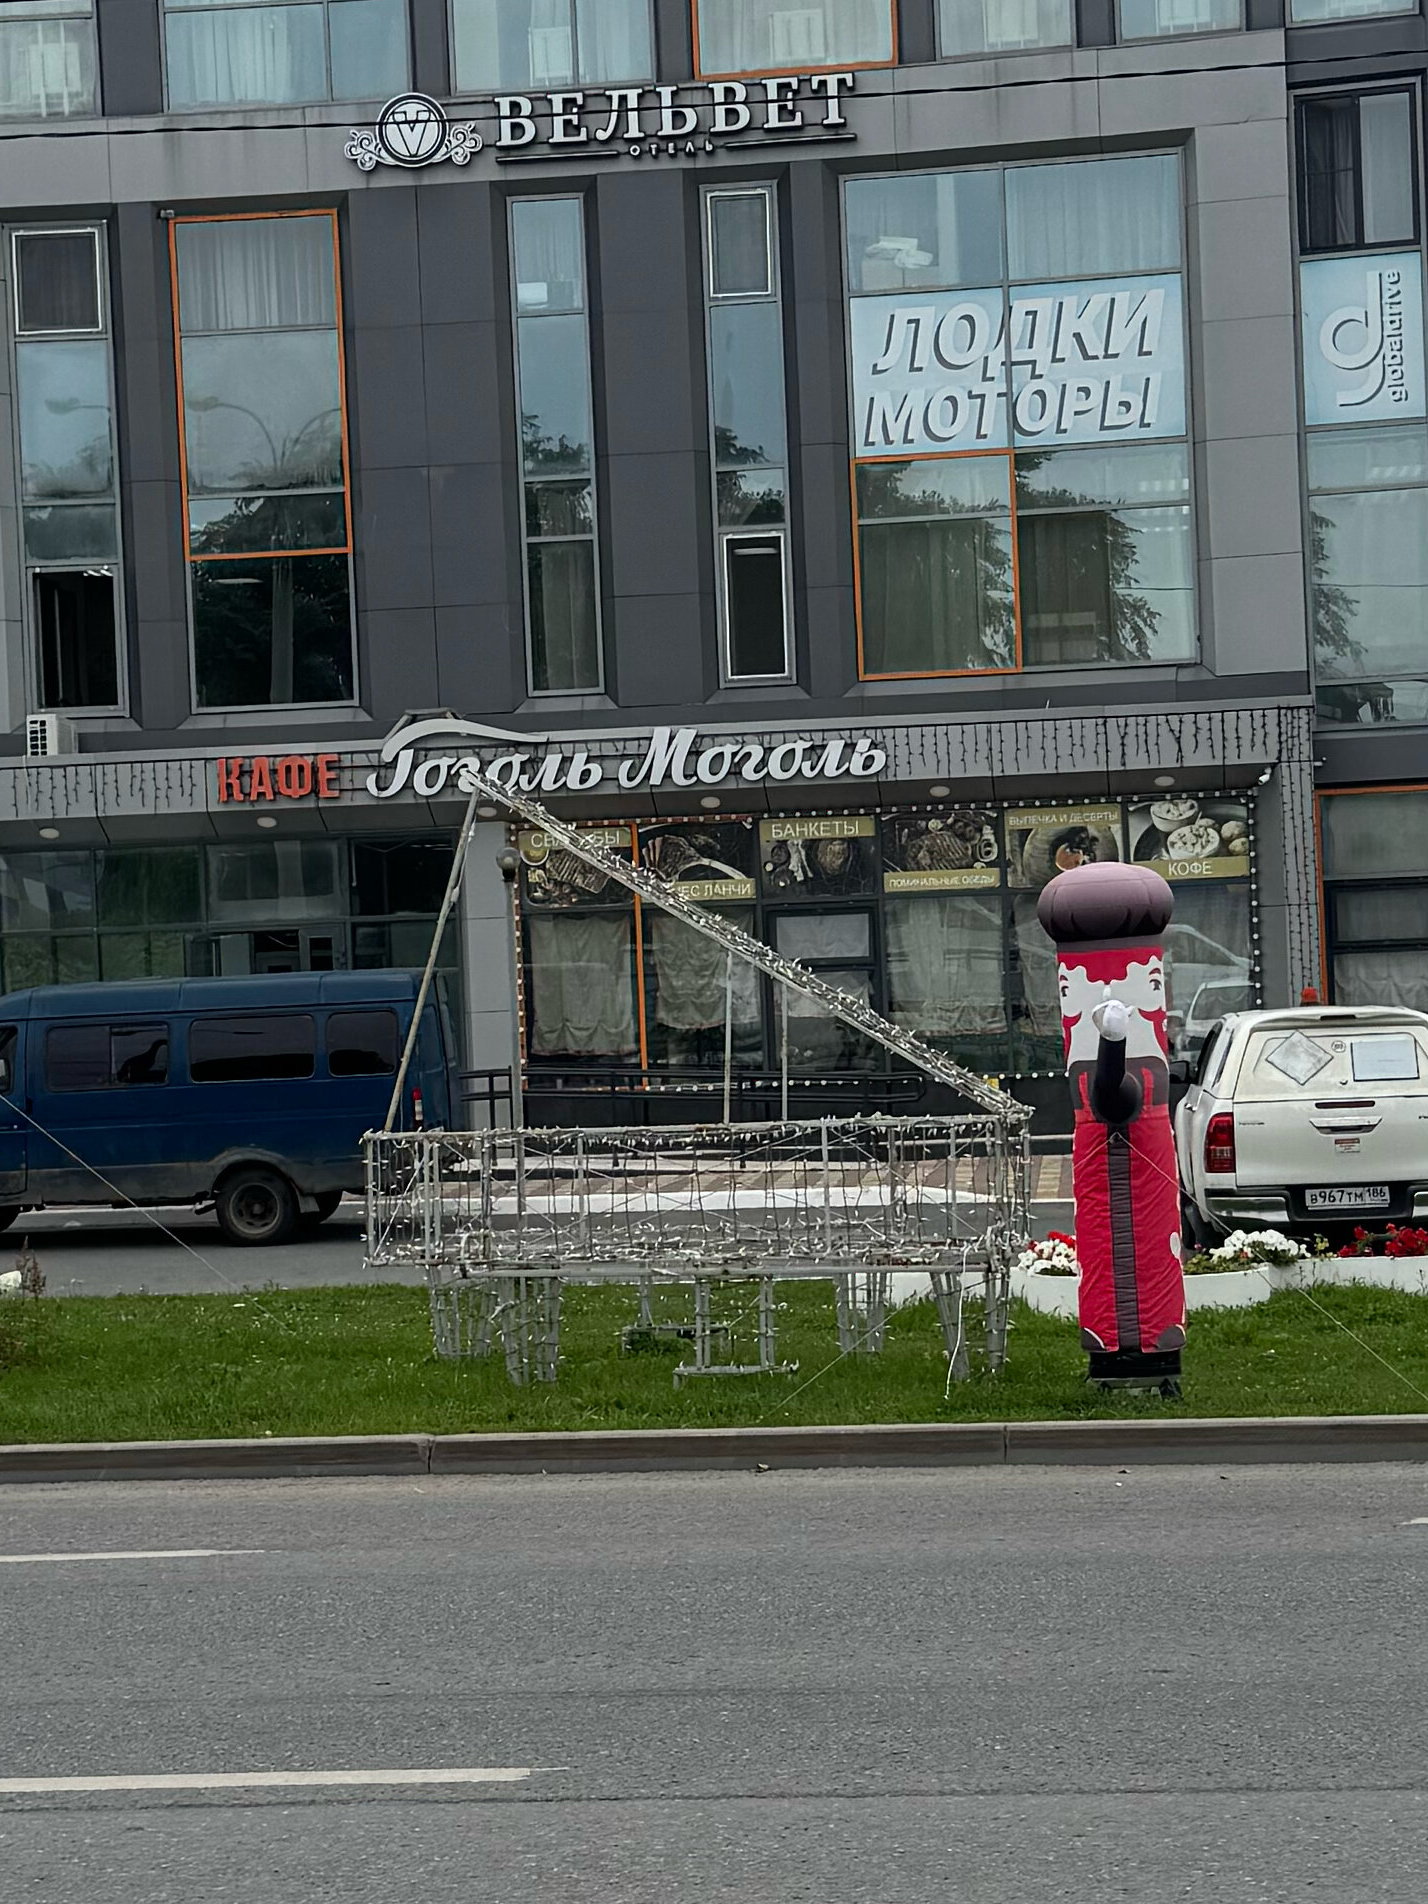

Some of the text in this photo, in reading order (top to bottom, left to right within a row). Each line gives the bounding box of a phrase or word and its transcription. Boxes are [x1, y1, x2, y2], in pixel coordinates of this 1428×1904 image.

[494, 73, 853, 146] ВЕЛЬВЕТ
[871, 289, 1165, 382] ЛОДКИ
[1384, 269, 1409, 404] globaldrive
[863, 371, 1162, 447] МОТОРЫ
[217, 753, 340, 803] КАФЕ
[618, 727, 887, 788] Моголь
[771, 819, 860, 839] БАНКЕТЫ
[703, 883, 752, 897] ЛАНЧИ
[1168, 860, 1213, 877] КОФЕ
